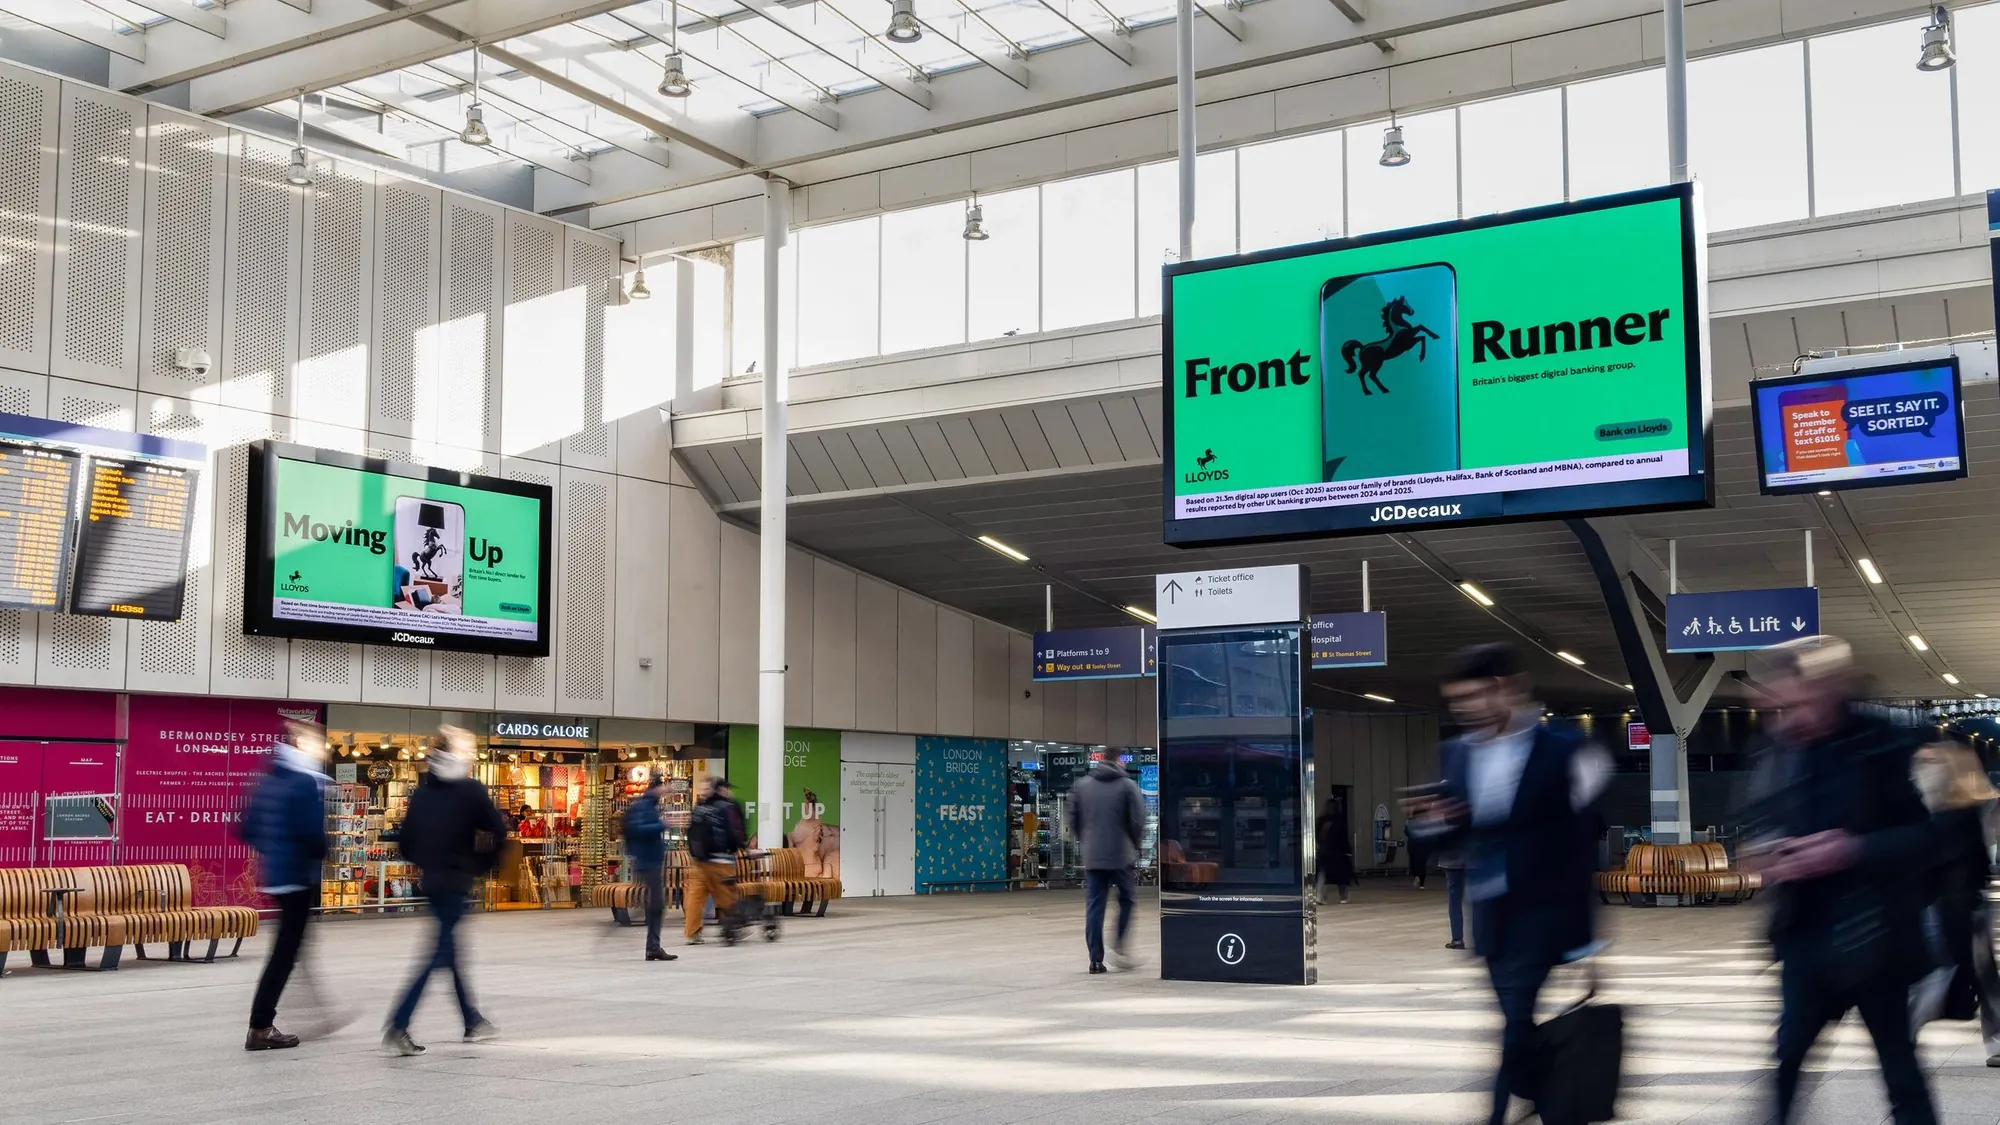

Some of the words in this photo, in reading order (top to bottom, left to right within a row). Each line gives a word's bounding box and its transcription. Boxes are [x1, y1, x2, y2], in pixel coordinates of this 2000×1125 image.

[1472, 308, 1670, 364] Runner
[1184, 348, 1311, 398] Front
[1472, 376, 1506, 386] Britain's
[1508, 372, 1539, 384] biggest
[1540, 368, 1568, 380] digital
[1570, 364, 1605, 376] banking
[1607, 361, 1636, 372] group.
[1849, 404, 1875, 418] SEE
[1877, 402, 1892, 414] IT.
[1896, 400, 1921, 413] SAY
[1924, 398, 1940, 410] IT.
[1792, 410, 1819, 420] Speak
[1800, 418, 1836, 427] member
[1868, 416, 1928, 431] SORTED.
[1600, 427, 1623, 437] Bank
[1638, 423, 1667, 434] Lloyds
[1805, 426, 1826, 435] staff
[1815, 435, 1840, 443] 61016
[1185, 470, 1229, 483] LLOYDS
[1235, 493, 1255, 501] digital
[1305, 486, 1324, 495] 2025)
[1361, 481, 1382, 489] family
[1446, 473, 1474, 482] Halifax,
[1505, 467, 1537, 476] Scotland
[1555, 463, 1584, 472] MBNA),
[1586, 460, 1624, 470] compared
[1636, 455, 1663, 464] annual
[1208, 503, 1236, 512] reported
[1277, 497, 1303, 505] banking
[1370, 504, 1461, 522] JCDecaux
[284, 512, 387, 555] Moving
[469, 537, 503, 568] Up
[1208, 574, 1231, 583] Ticket
[1233, 573, 1254, 581] office
[281, 583, 309, 593] LLOYDS
[1208, 587, 1233, 596] Toilets
[1313, 621, 1334, 629] office
[1750, 616, 1780, 632] Lift
[392, 632, 434, 644] JCDecaux
[1311, 635, 1342, 644] Hospital
[1057, 648, 1088, 657] Platforms
[1057, 663, 1071, 672] Way
[160, 730, 245, 742] BERMONDSEY
[251, 733, 287, 743] STREE
[497, 723, 539, 736] CARDS
[542, 725, 589, 738] GALORE
[176, 744, 229, 753] LONDON
[943, 749, 982, 760] LONDON
[1053, 757, 1076, 765] COLD
[946, 762, 980, 774] BRIDGE
[146, 812, 176, 823] EAT
[190, 812, 242, 823] DRINK
[801, 803, 825, 820] UP
[940, 805, 985, 821] FEAST
